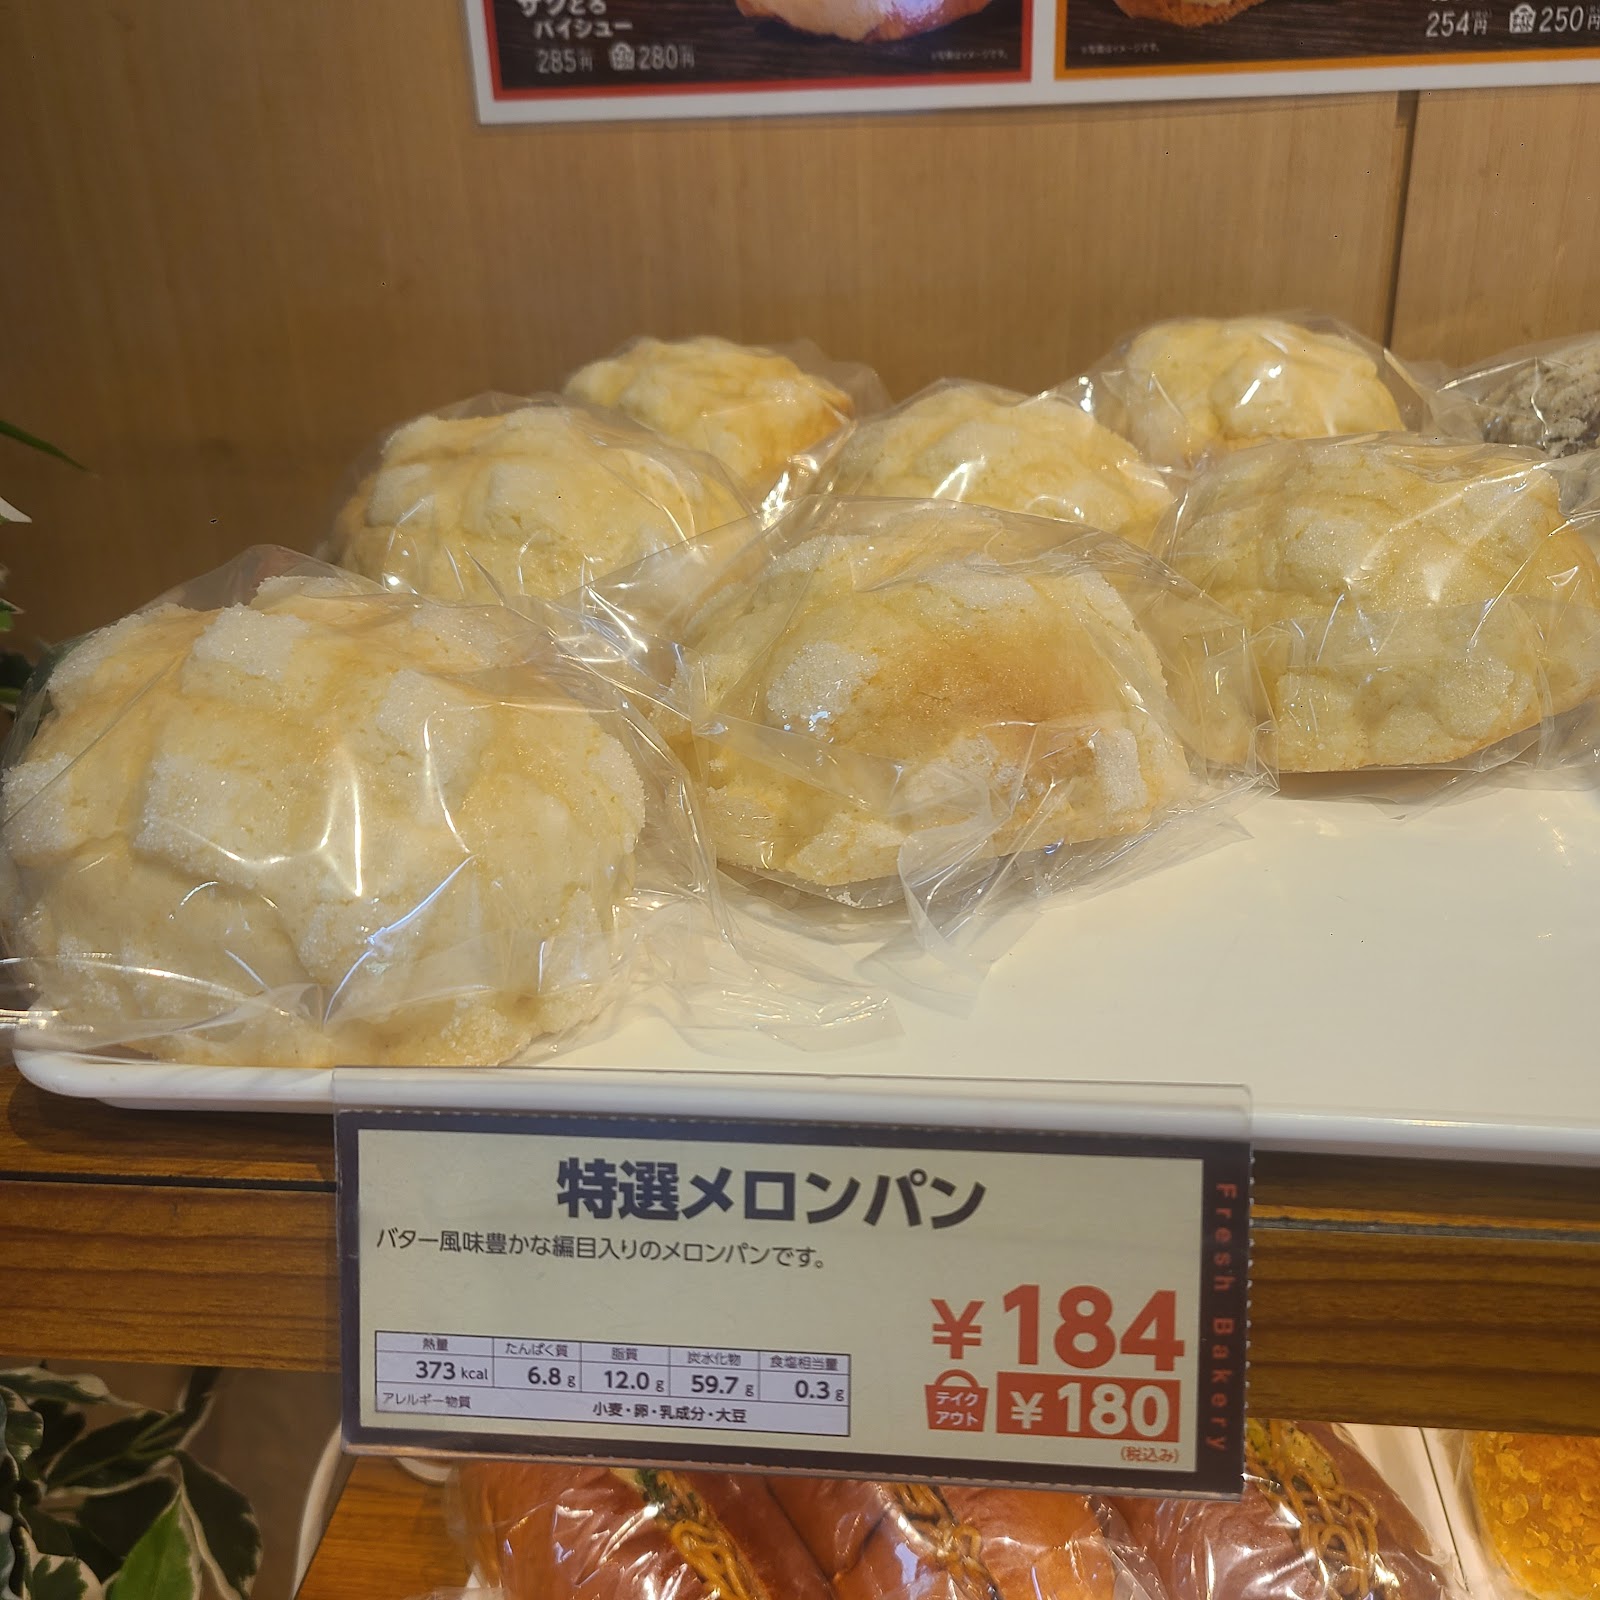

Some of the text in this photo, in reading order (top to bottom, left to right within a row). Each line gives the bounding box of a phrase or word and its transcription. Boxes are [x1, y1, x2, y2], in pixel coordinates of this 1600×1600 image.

[557, 1156, 987, 1230] 特選メロンパン
[377, 1228, 826, 1270] バター風味豊かな編目入りのメロンパンです。
[1206, 1182, 1237, 1452] Fresh Bakery
[422, 1337, 839, 1372] 熱量 たんぱく質 脂質 炭水化物 食塩相当量
[416, 1360, 845, 1403] 373 kcal 6.8 g 12.0 g 59.7 g 0.3 g
[936, 1391, 979, 1407] テイク
[382, 1391, 748, 1424] アレルギー物質 小麦・卵・乳成分・大豆
[935, 1410, 979, 1427] アウト
[1120, 1446, 1180, 1464] (税込み)
